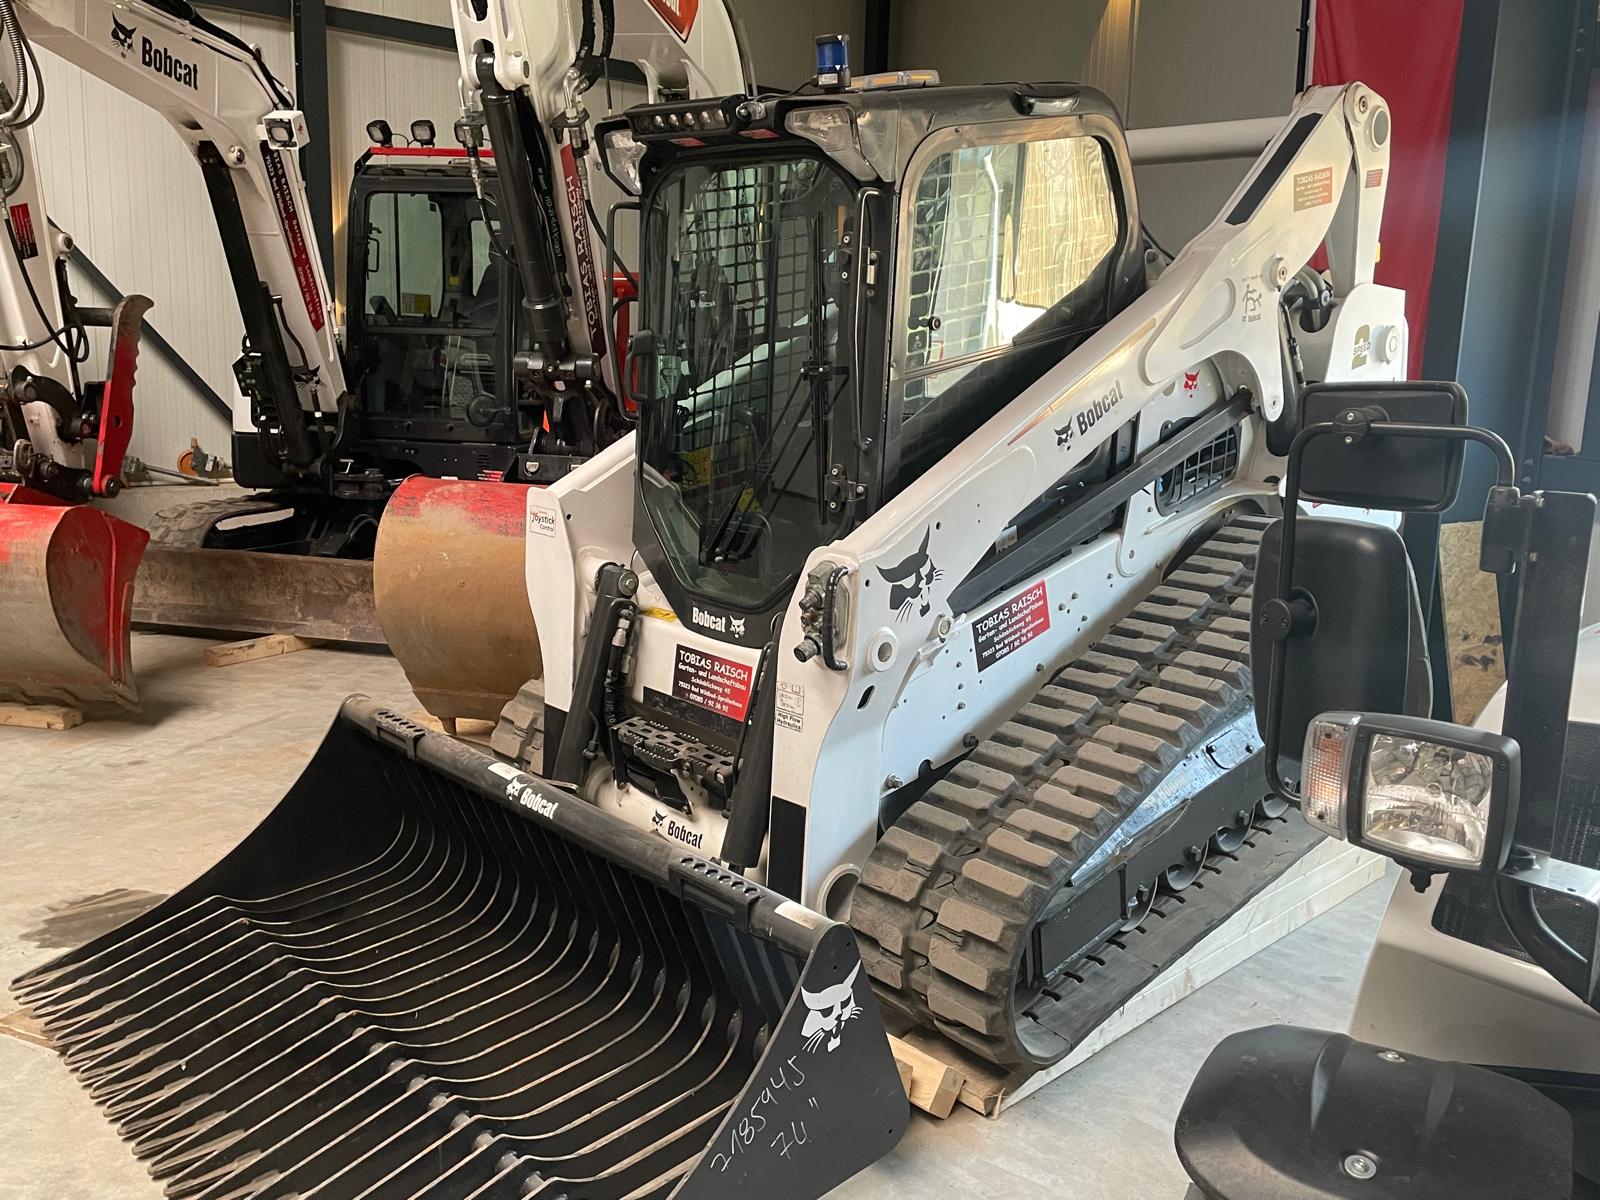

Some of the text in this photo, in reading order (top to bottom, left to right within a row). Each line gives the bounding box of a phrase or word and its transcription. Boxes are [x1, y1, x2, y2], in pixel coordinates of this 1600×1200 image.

[141, 36, 198, 90] Bobcat
[279, 177, 294, 212] RAISCH
[564, 174, 585, 255] RAISCH
[578, 260, 598, 339] TOBIAS
[1077, 380, 1123, 436] Bobcat
[692, 606, 726, 633] Bobcat
[976, 587, 1043, 634] TOBIAS RAISCH
[979, 629, 997, 643] Garten-
[999, 621, 1007, 631] und
[996, 642, 1004, 650] Bad
[678, 662, 747, 691] Garten- und Landschaftsbau
[679, 650, 748, 682] TOBIAS RAISCH
[691, 685, 700, 693] Bad
[520, 788, 559, 819] Bobcat
[668, 820, 703, 850] Bobcat
[710, 1056, 804, 1173] 2185945
